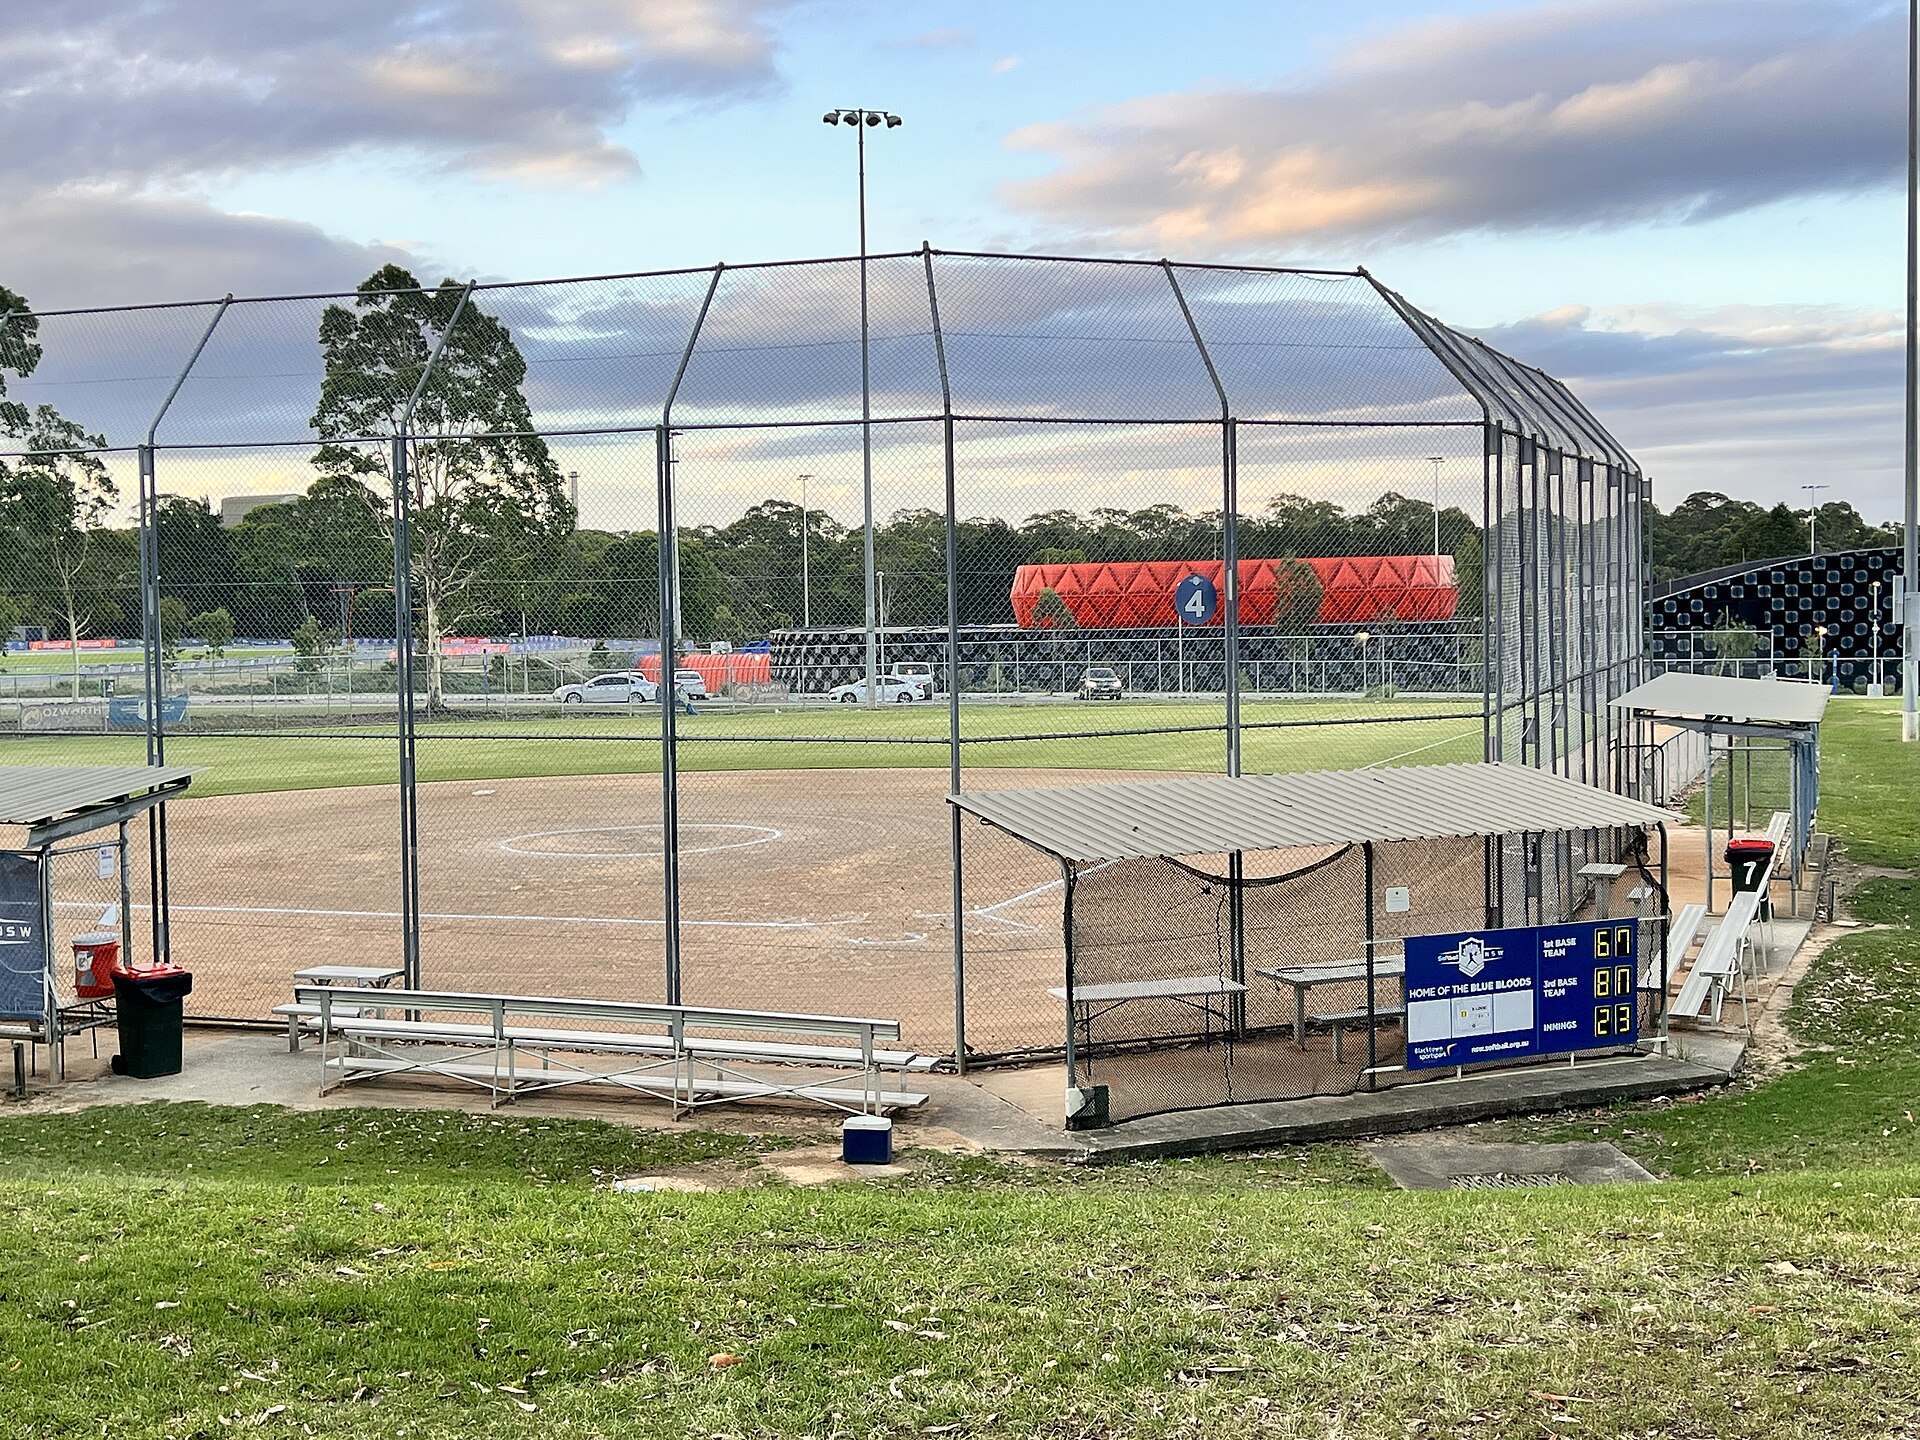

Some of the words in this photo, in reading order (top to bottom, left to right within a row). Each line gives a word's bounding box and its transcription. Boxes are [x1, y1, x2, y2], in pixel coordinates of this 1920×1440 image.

[1184, 589, 1205, 618] 4
[42, 705, 102, 717] OZWORTH
[1743, 861, 1757, 885] 7
[1543, 940, 1554, 949] 1st
[1555, 937, 1577, 947] BASE
[1543, 948, 1566, 958] TEAM
[1409, 987, 1436, 999] HOME
[1437, 986, 1451, 996] OF
[1452, 984, 1469, 994] THE
[1470, 981, 1494, 993] BLUE
[1495, 977, 1532, 990] BLOODS
[1543, 980, 1556, 989] 3rd
[1557, 977, 1578, 987] BASE
[1543, 988, 1566, 998] TEAM
[1543, 1021, 1578, 1032] INNINGS
